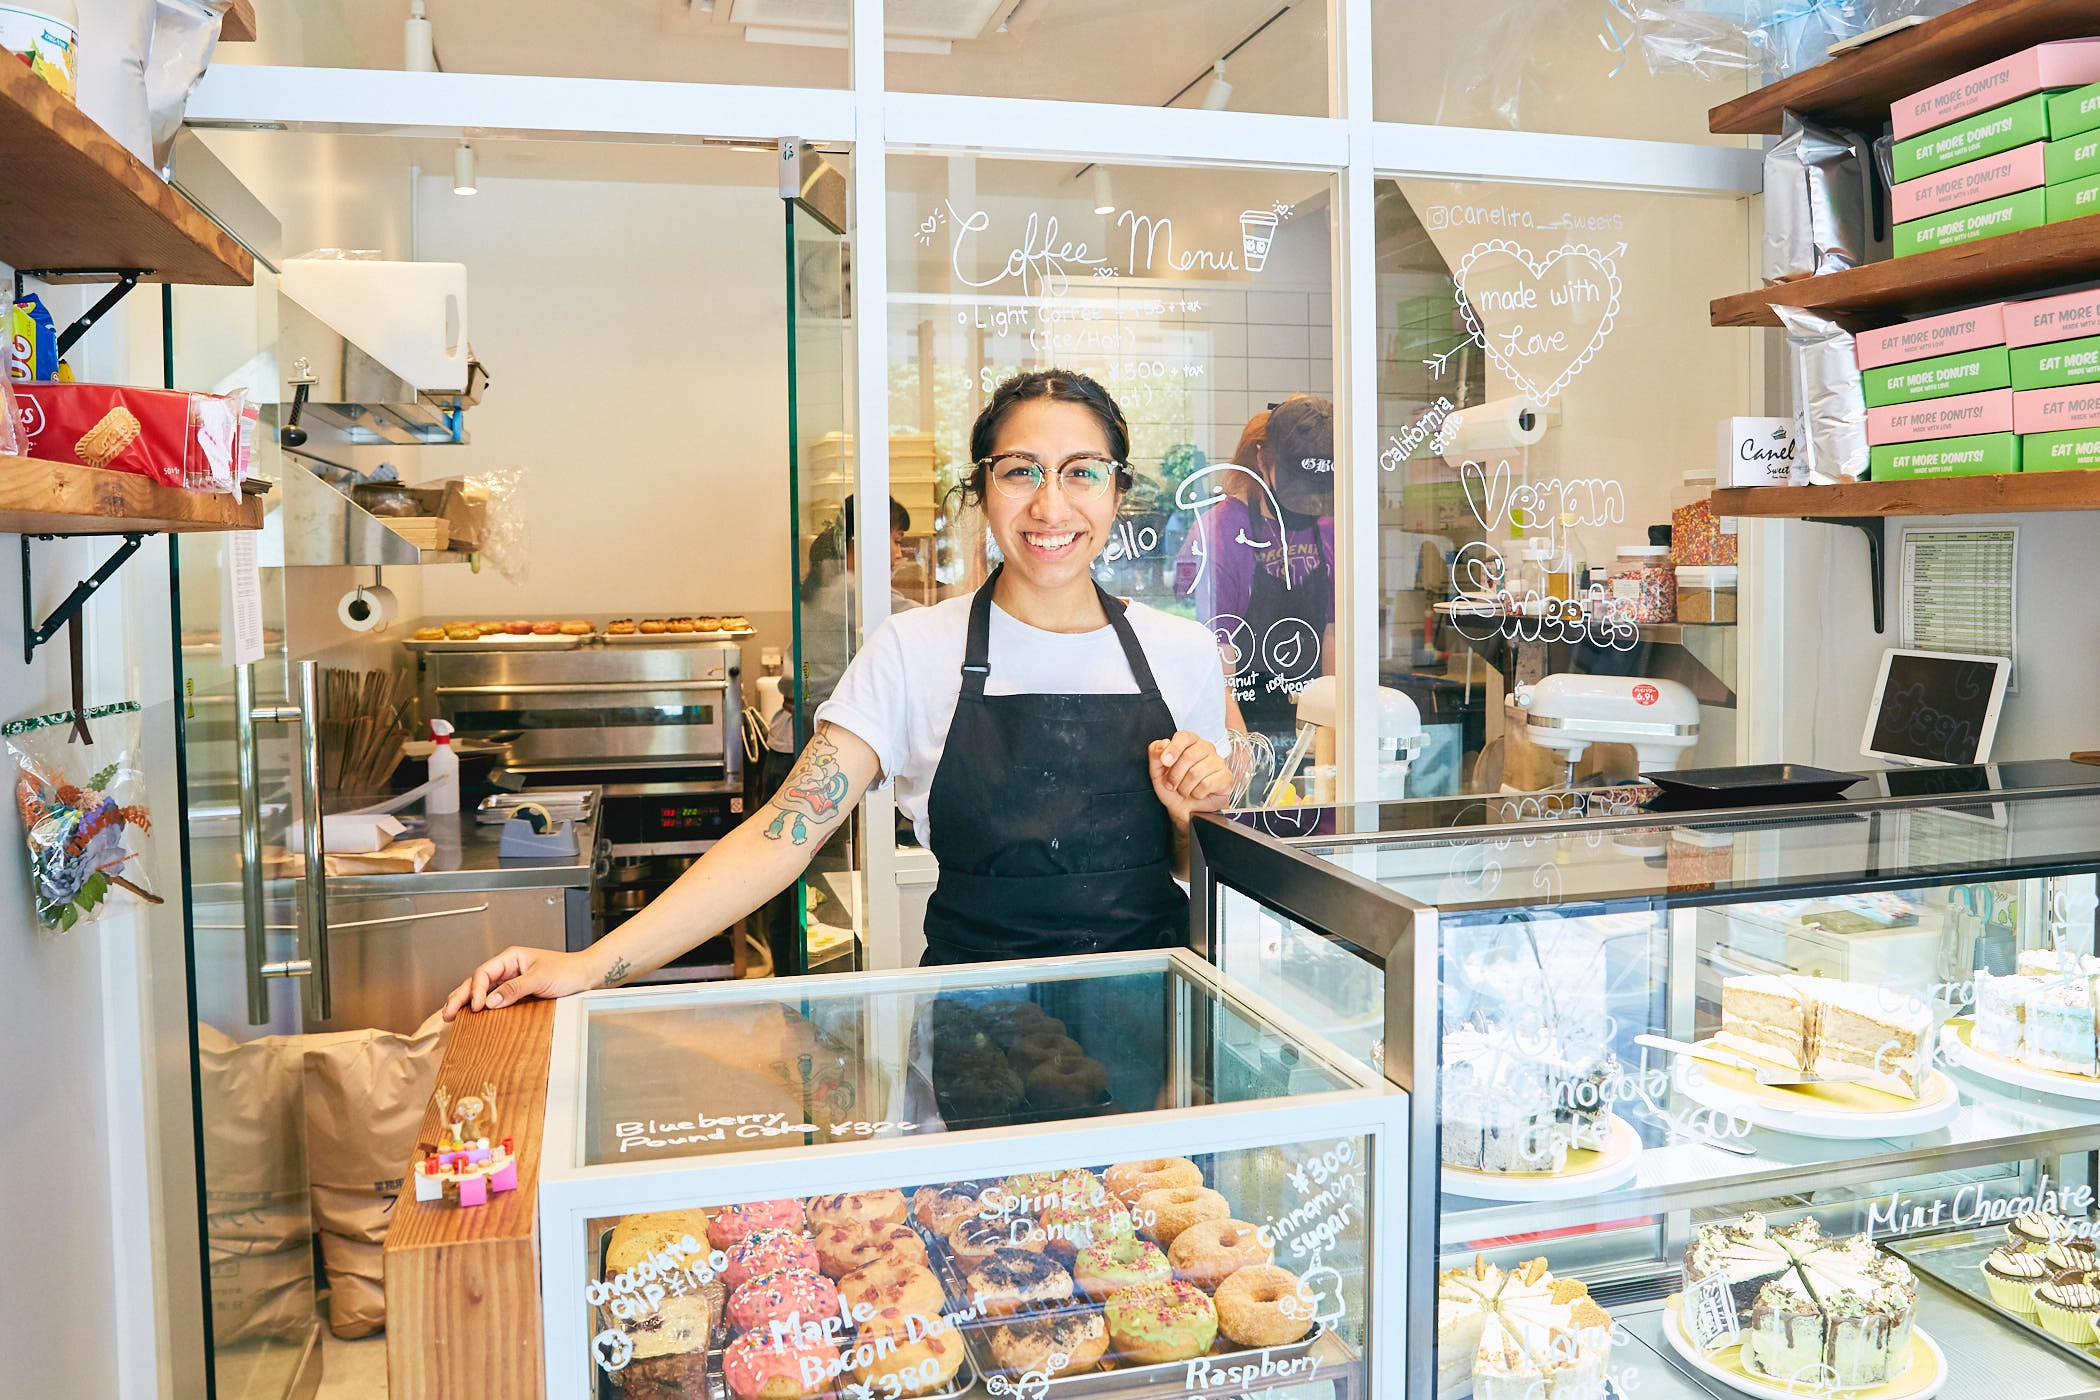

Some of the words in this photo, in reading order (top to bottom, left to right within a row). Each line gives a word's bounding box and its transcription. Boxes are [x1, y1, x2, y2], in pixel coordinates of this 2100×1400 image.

[1914, 100, 1931, 116] EAT
[1935, 89, 1962, 108] MORE
[1916, 144, 1934, 160] EAT
[1936, 134, 1965, 154] MORE
[2074, 143, 2098, 161] EAT
[1915, 187, 1933, 202] EAT
[1935, 178, 1964, 196] MORE
[2076, 187, 2099, 205] EAT
[1917, 228, 1935, 243] EAT
[1936, 220, 1965, 237] MORE
[945, 199, 1107, 300] Coffee
[1117, 210, 1240, 275] Menu
[1480, 281, 1539, 312] made
[1550, 278, 1600, 306] with
[975, 303, 1029, 338] Light
[2033, 312, 2055, 327] EAT
[2058, 306, 2092, 322] MORE
[1498, 325, 1569, 357] Love
[1881, 336, 1899, 350] EAT
[1901, 331, 1929, 346] MORE
[1931, 320, 1976, 340] DONUTS!
[2039, 356, 2062, 371] EAT
[2064, 350, 2099, 367] MORE
[1887, 376, 1904, 390] EAT
[1907, 371, 1934, 386] MORE
[1936, 362, 1980, 381] DONUTS!
[1891, 416, 1909, 428] EAT
[1910, 412, 1938, 425] MORE
[1940, 406, 1983, 422] DONUTS!
[2043, 401, 2065, 415] EAT
[1379, 395, 1455, 472] California
[1428, 413, 1465, 457] style
[1741, 438, 1796, 461] Canel
[1893, 455, 1910, 468] EAT
[1912, 453, 1939, 466] MORE
[1941, 449, 1985, 464] DONUTS!
[2051, 443, 2074, 457] EAT
[2075, 441, 2100, 455] MOR
[1767, 463, 1790, 475] Sweet
[1460, 460, 1625, 573] Vegan
[1450, 541, 1639, 651] Sweets
[1224, 671, 1260, 688] eanut
[1231, 688, 1256, 702] free
[615, 1112, 786, 1138] Blueberry
[619, 1128, 726, 1153] Pound
[978, 1175, 1109, 1224] Sprinkle
[1867, 1192, 1947, 1244] Mint
[1953, 1174, 2096, 1226] Chocolate
[1009, 1215, 1098, 1247] Donut
[769, 1294, 878, 1356] Maple
[800, 1330, 898, 1389] Bacon
[904, 1292, 989, 1344] Donut
[1186, 1351, 1325, 1390] Raspberry
